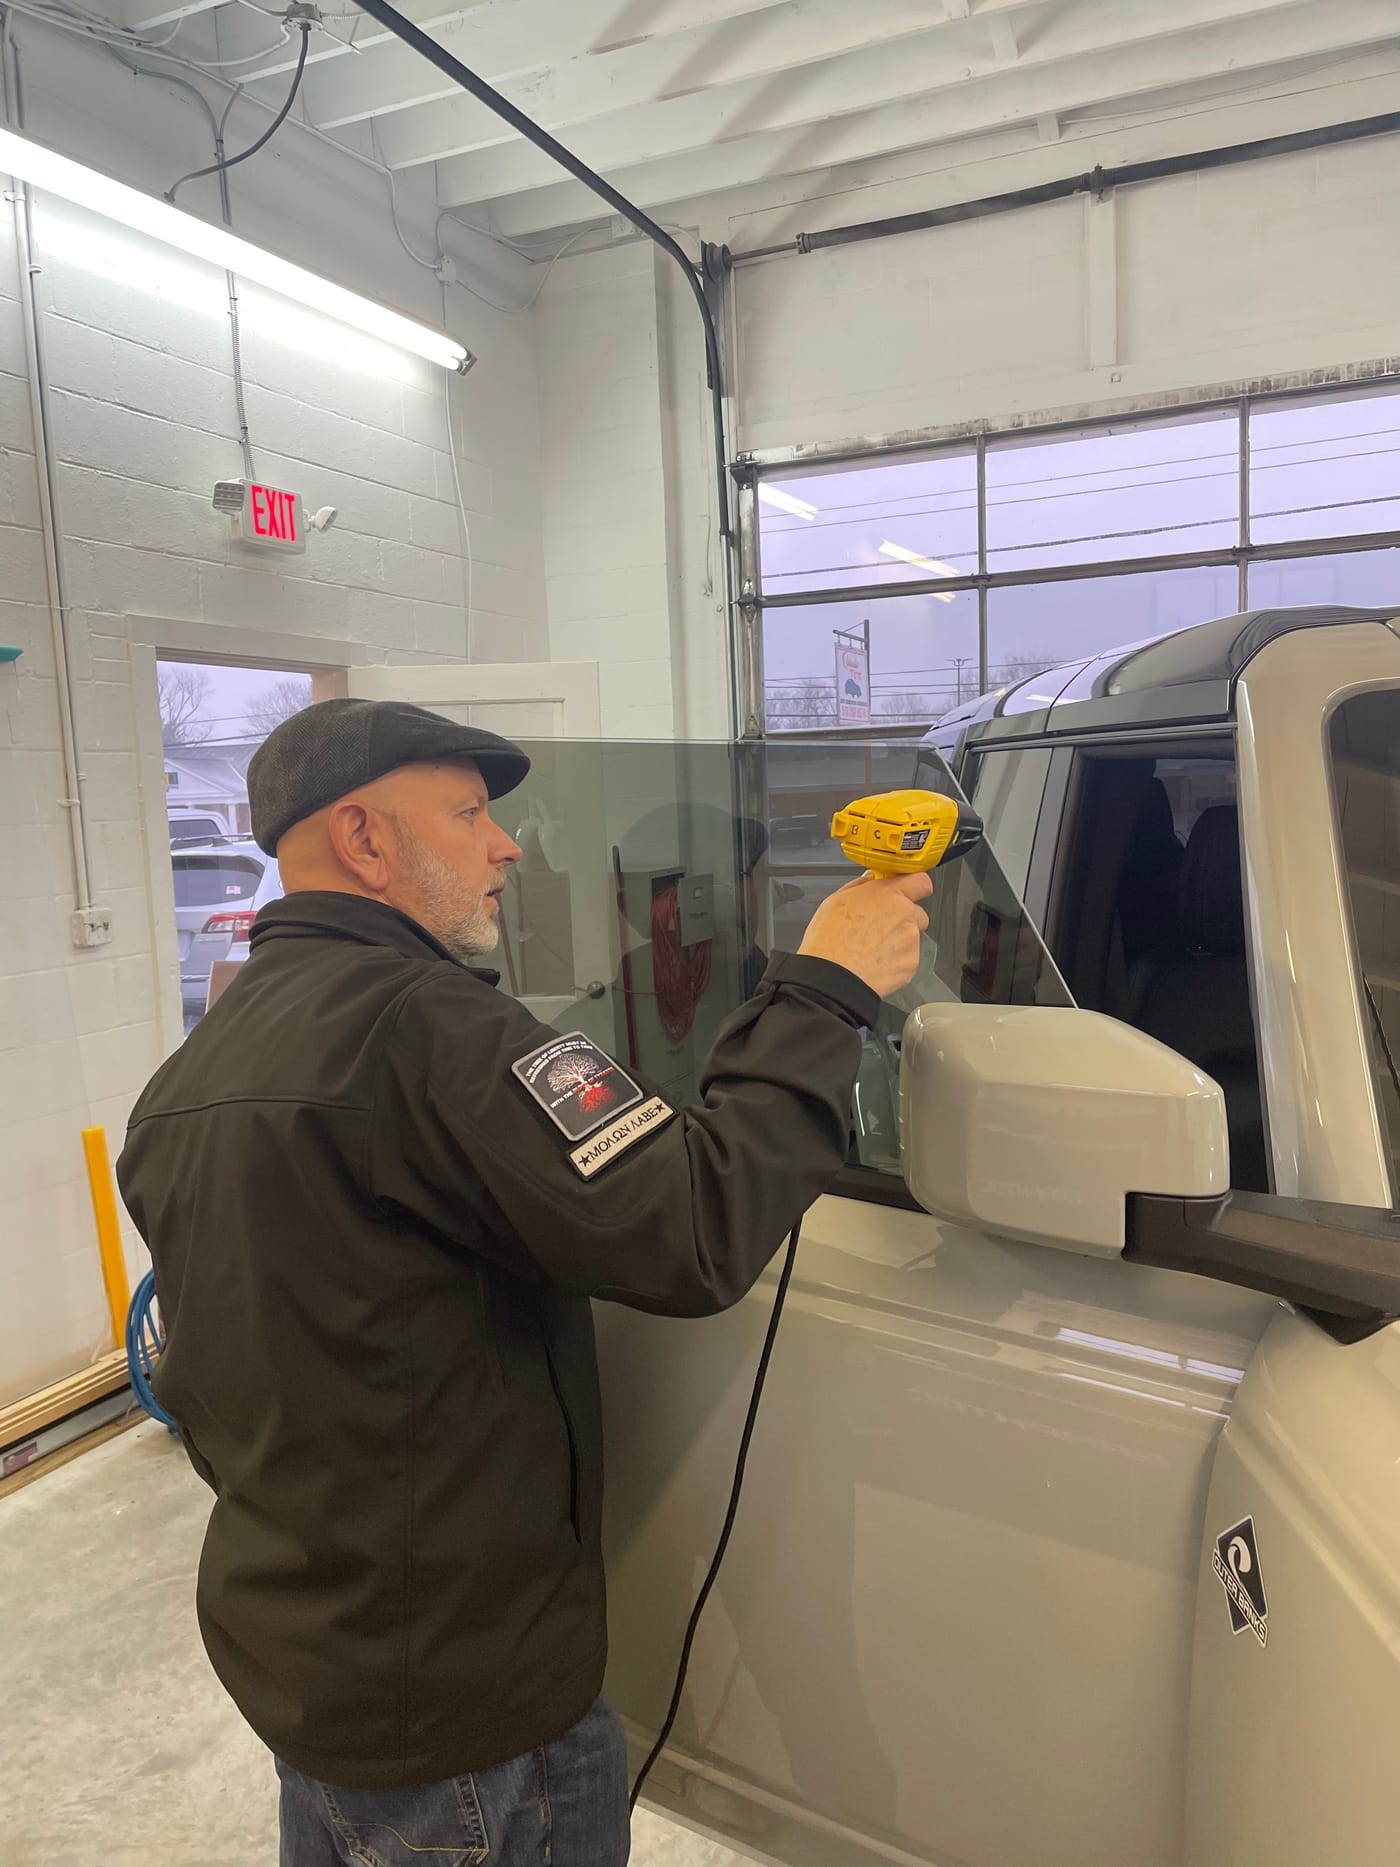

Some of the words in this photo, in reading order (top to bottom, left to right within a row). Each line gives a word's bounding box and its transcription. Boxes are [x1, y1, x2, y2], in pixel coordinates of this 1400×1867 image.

[250, 485, 295, 541] EXIT
[1213, 1555, 1239, 1600] OUTER
[1238, 1592, 1266, 1641] BANKS
